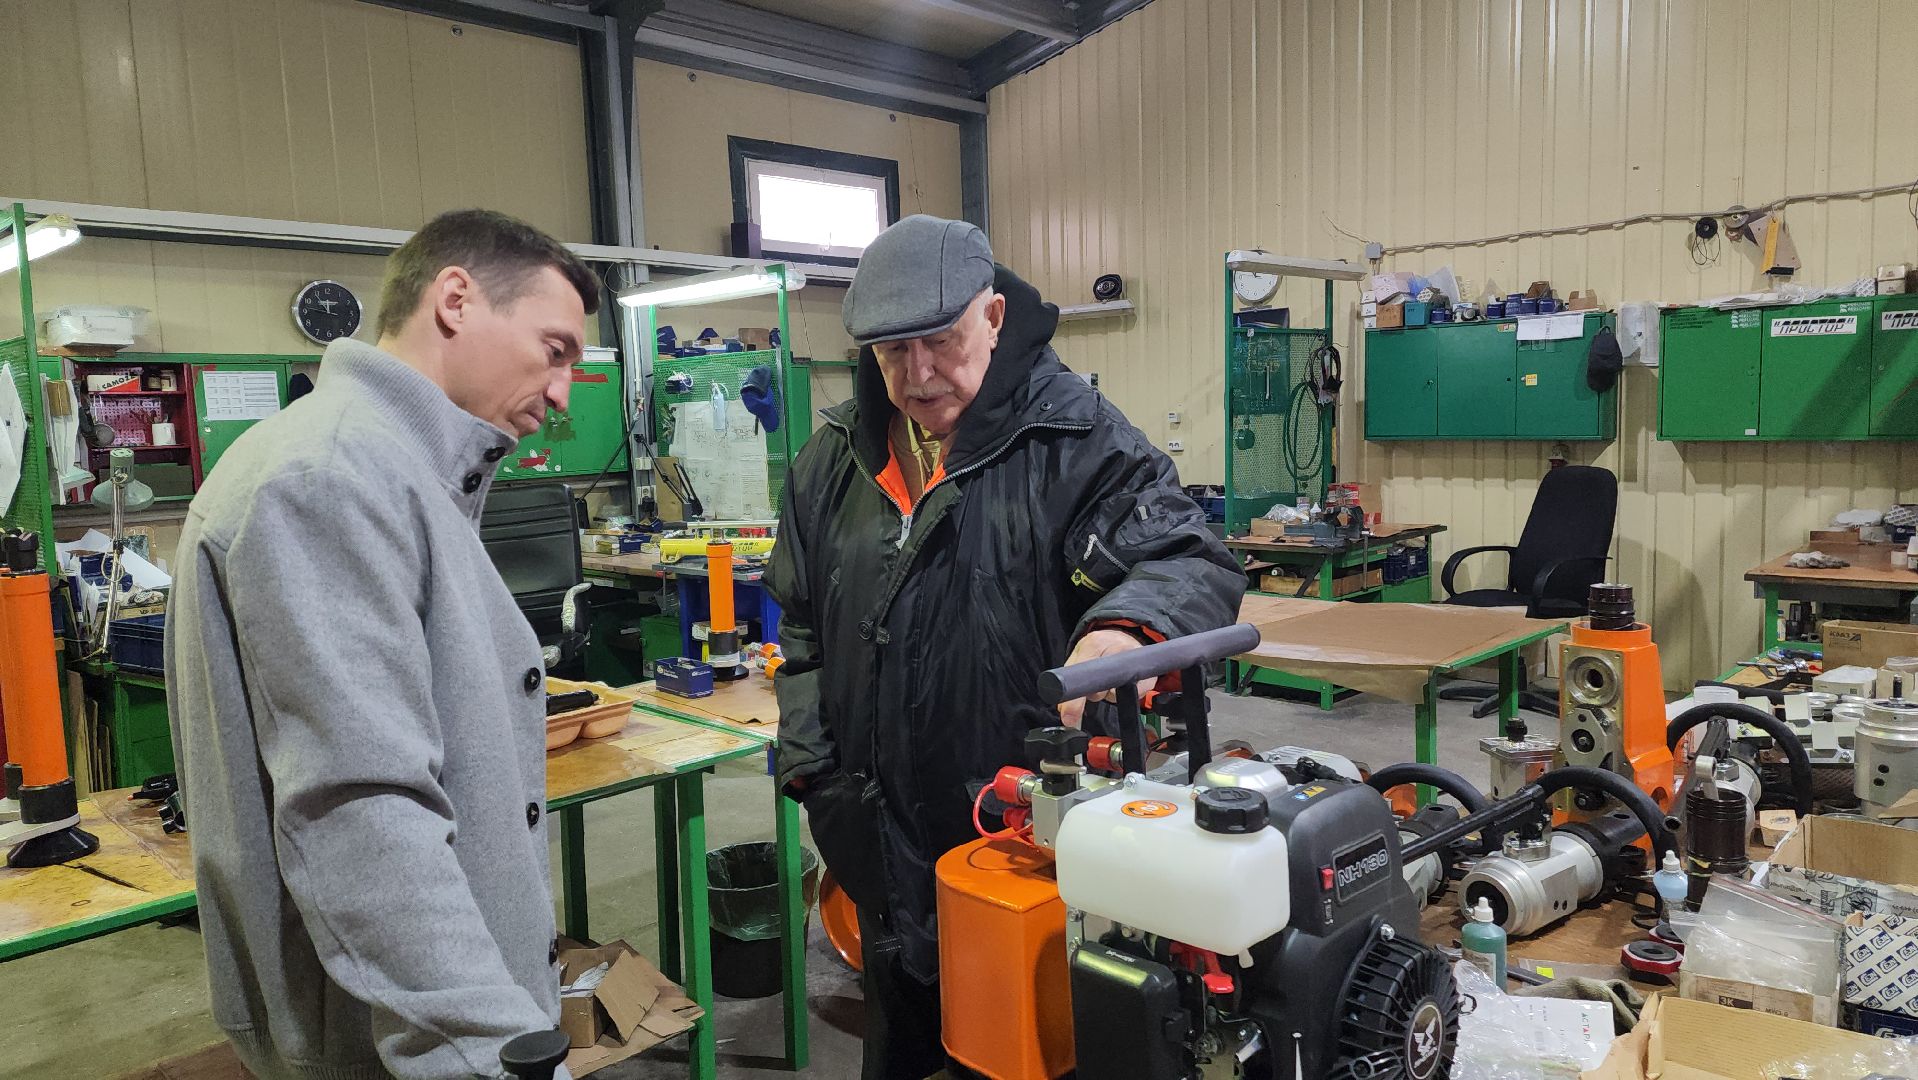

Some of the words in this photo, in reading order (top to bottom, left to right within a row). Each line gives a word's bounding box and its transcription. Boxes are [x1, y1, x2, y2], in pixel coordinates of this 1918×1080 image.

[324, 287, 331, 295] 12
[314, 328, 320, 336] 7
[326, 329, 332, 338] 6
[1338, 848, 1389, 887] NH130
